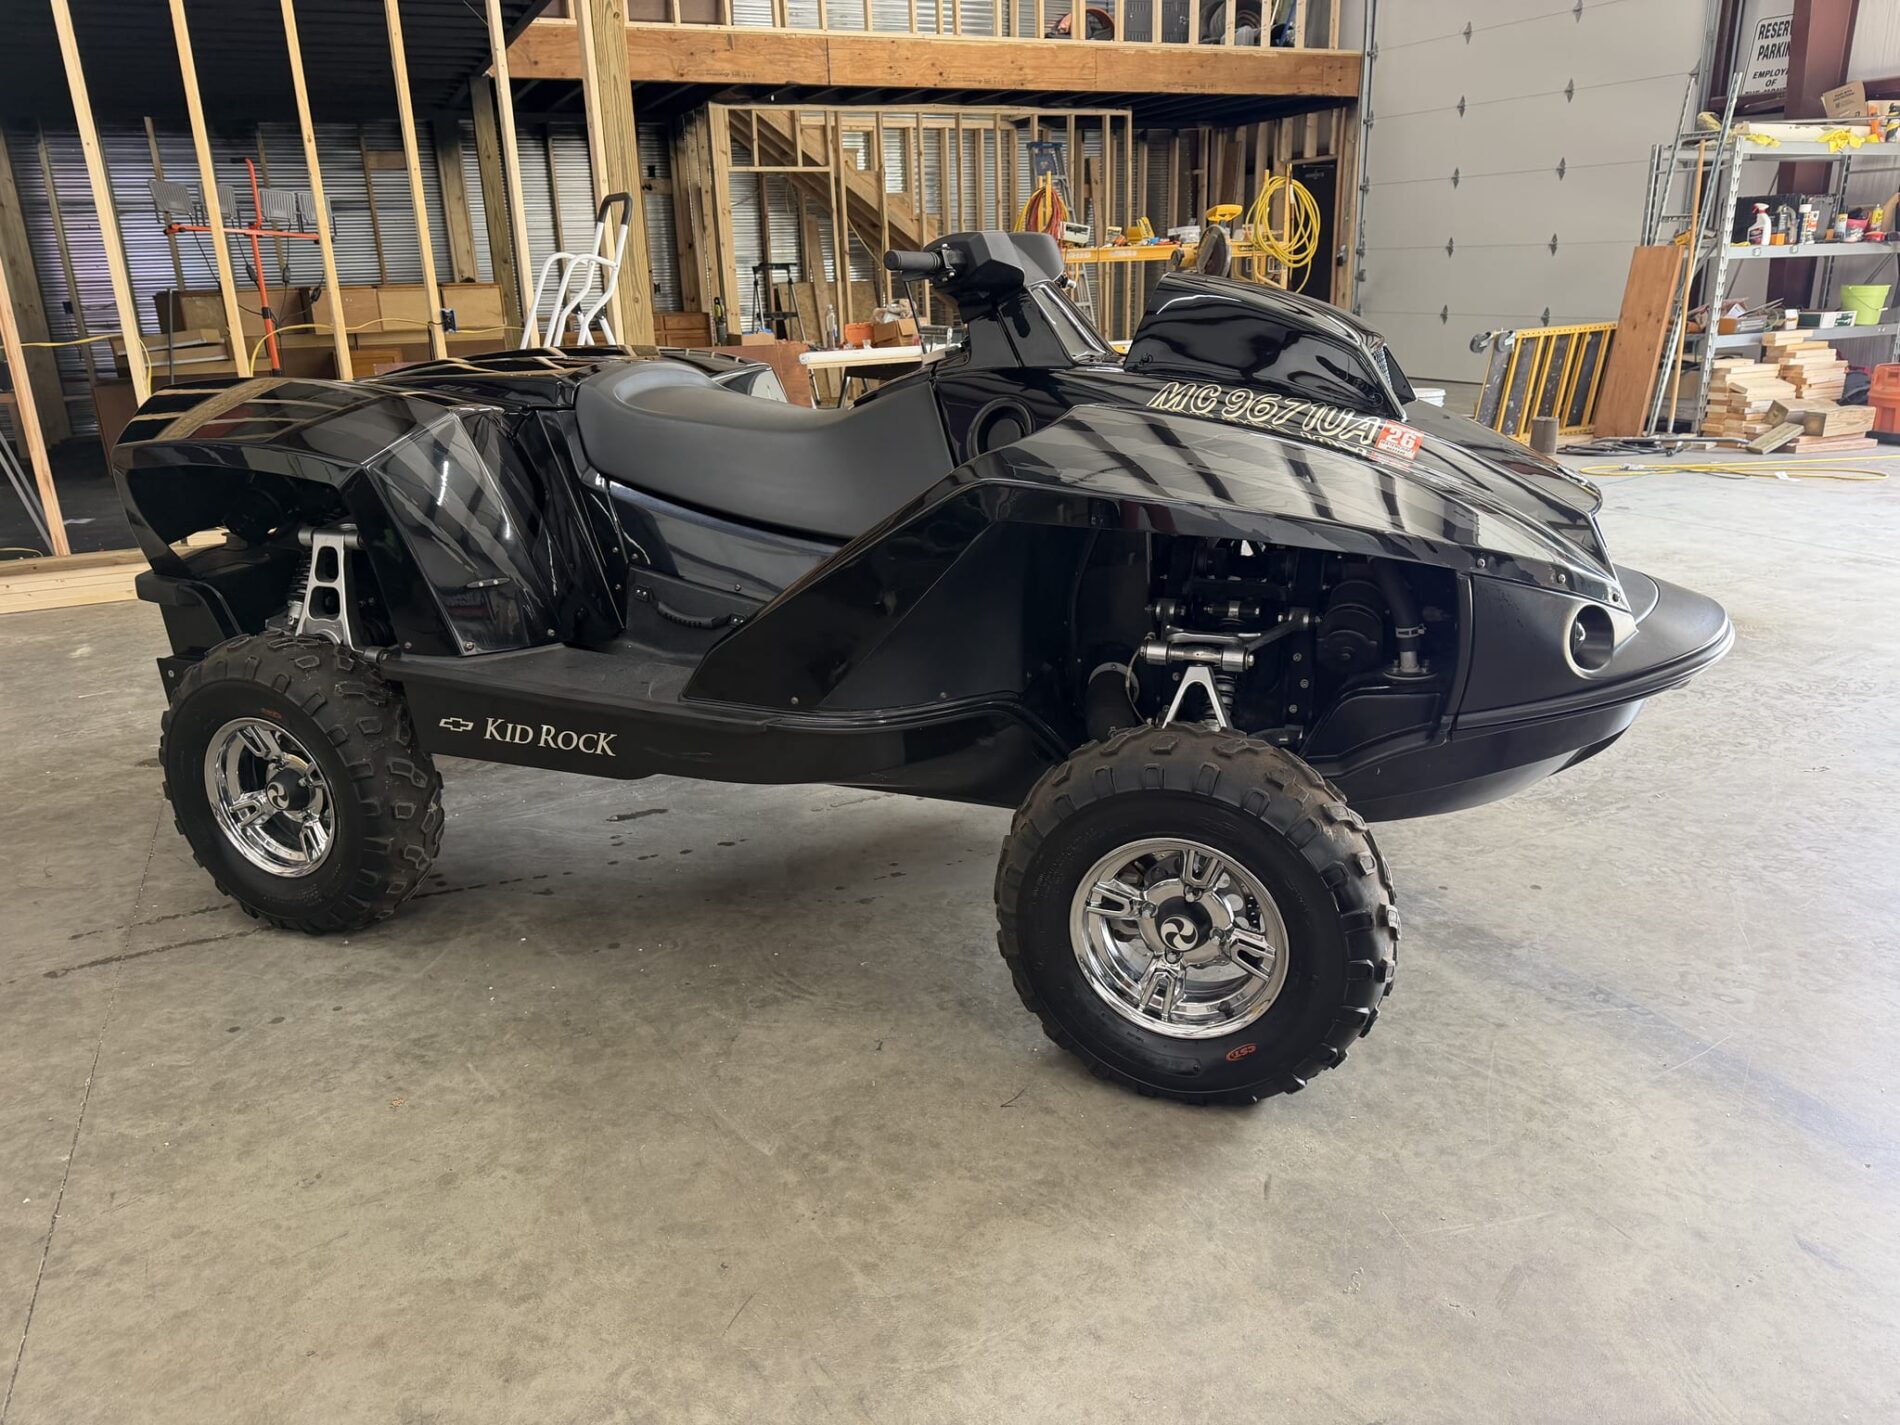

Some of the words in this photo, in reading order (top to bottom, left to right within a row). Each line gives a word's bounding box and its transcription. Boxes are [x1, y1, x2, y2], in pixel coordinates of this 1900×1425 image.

[1765, 79, 1777, 87] OF
[1146, 382, 1222, 413] MC
[1385, 427, 1416, 449] 26
[484, 718, 533, 744] KID
[538, 725, 617, 756] ROCK
